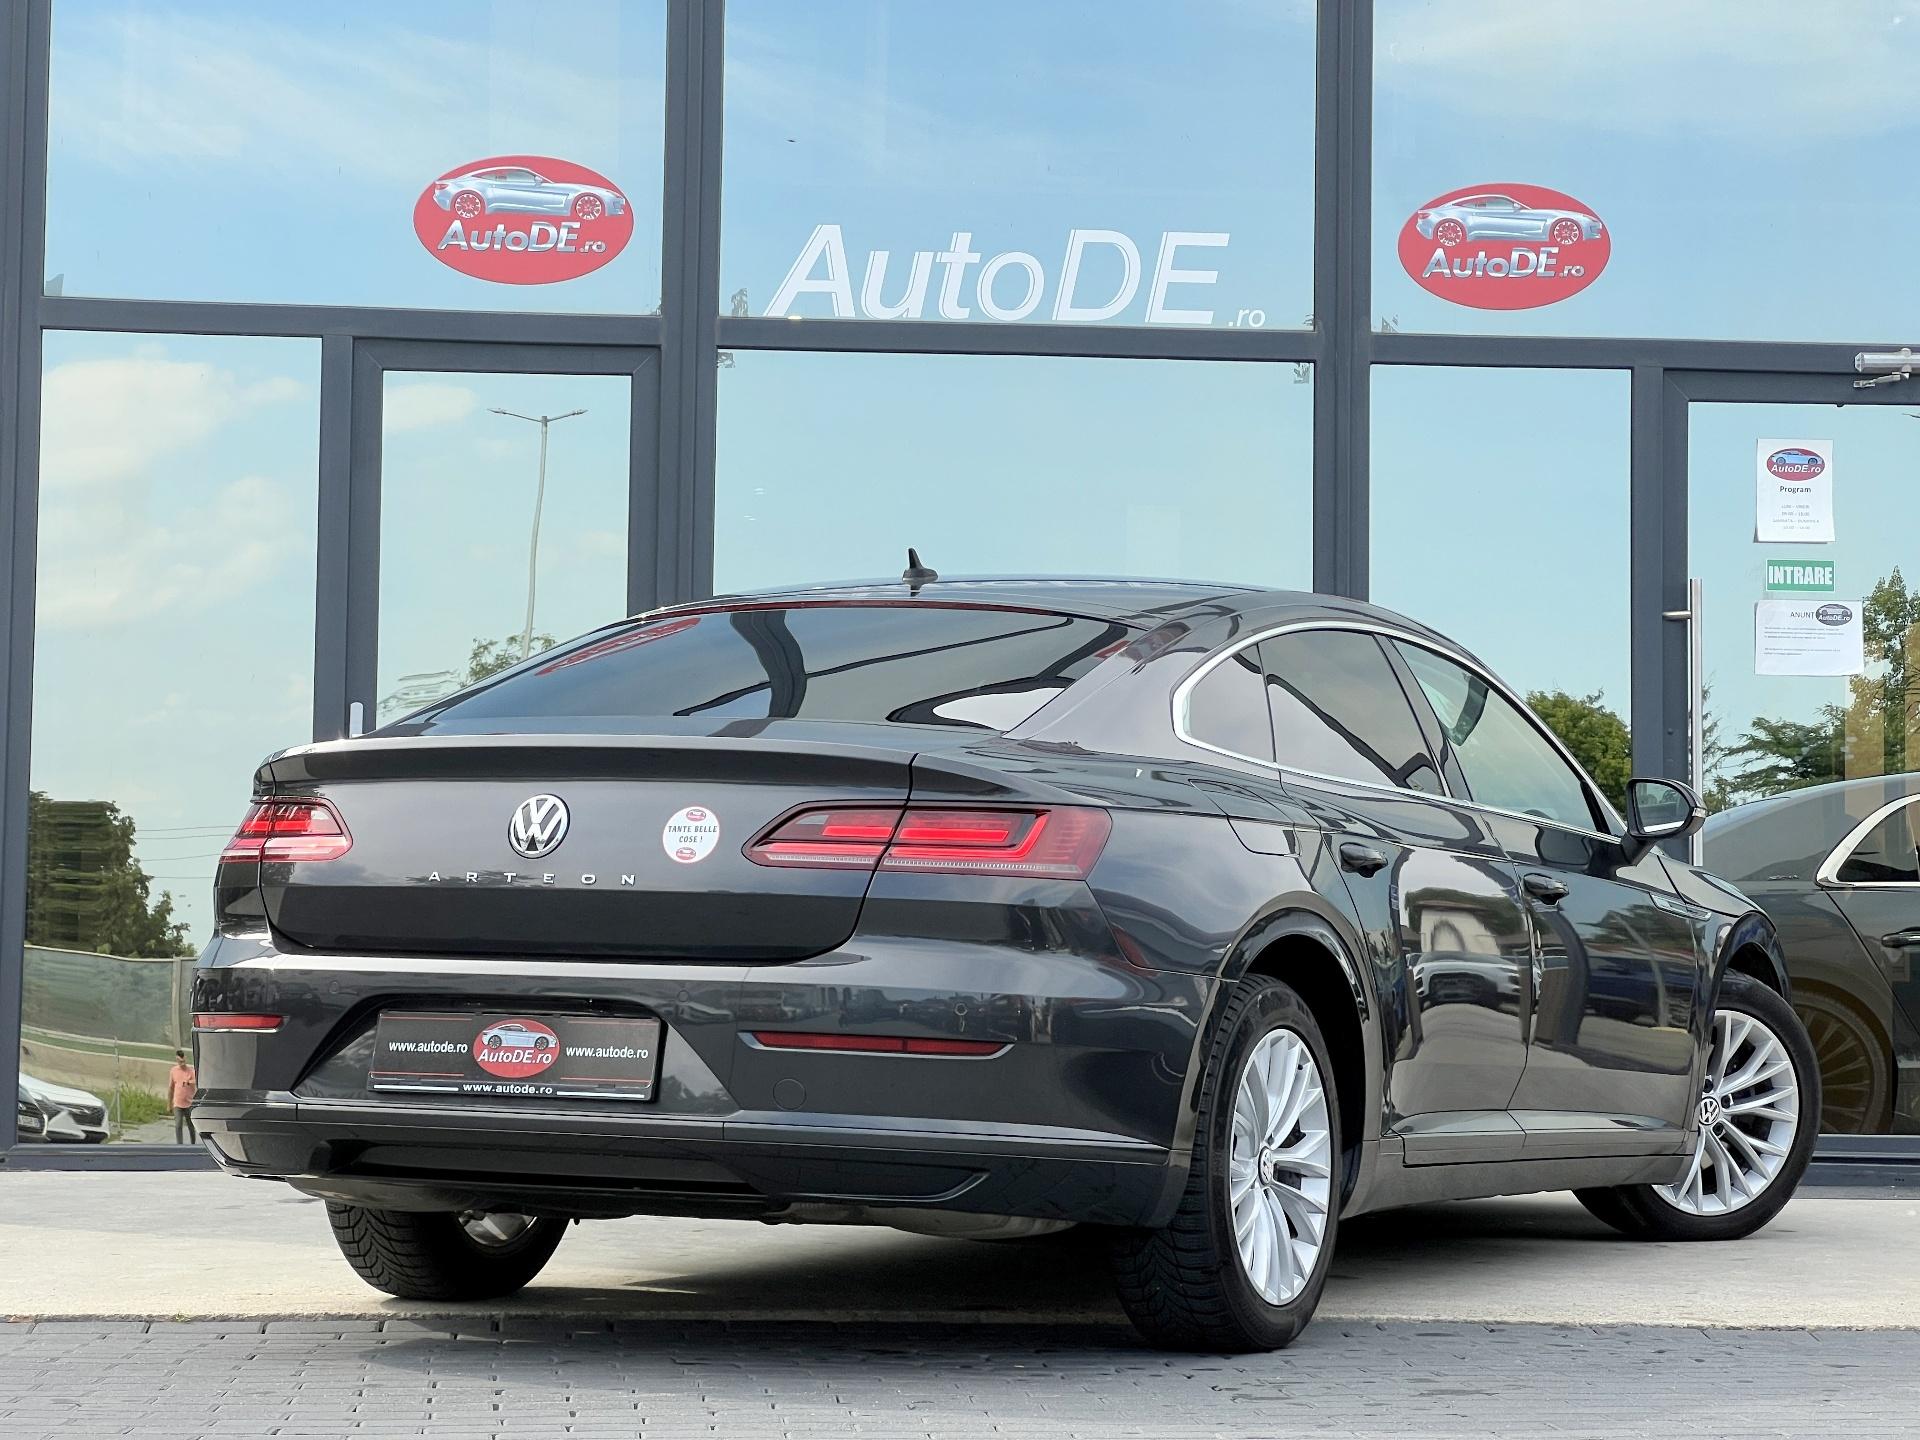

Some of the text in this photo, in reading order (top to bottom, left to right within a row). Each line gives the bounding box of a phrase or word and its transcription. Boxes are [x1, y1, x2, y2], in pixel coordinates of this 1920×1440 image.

[1770, 464, 1822, 473] AutoDE.ro
[1779, 485, 1812, 494] Program
[1768, 565, 1833, 585] INTRARE
[668, 825, 718, 833] TANTE BELLE
[679, 835, 698, 843] COSE
[428, 870, 636, 886] ARTEON
[388, 1040, 468, 1054] www.autode.ro
[565, 1046, 650, 1059] www.autode.ro
[477, 1048, 553, 1064] AutoDE.ro
[462, 1082, 554, 1095] www.autode.ro
